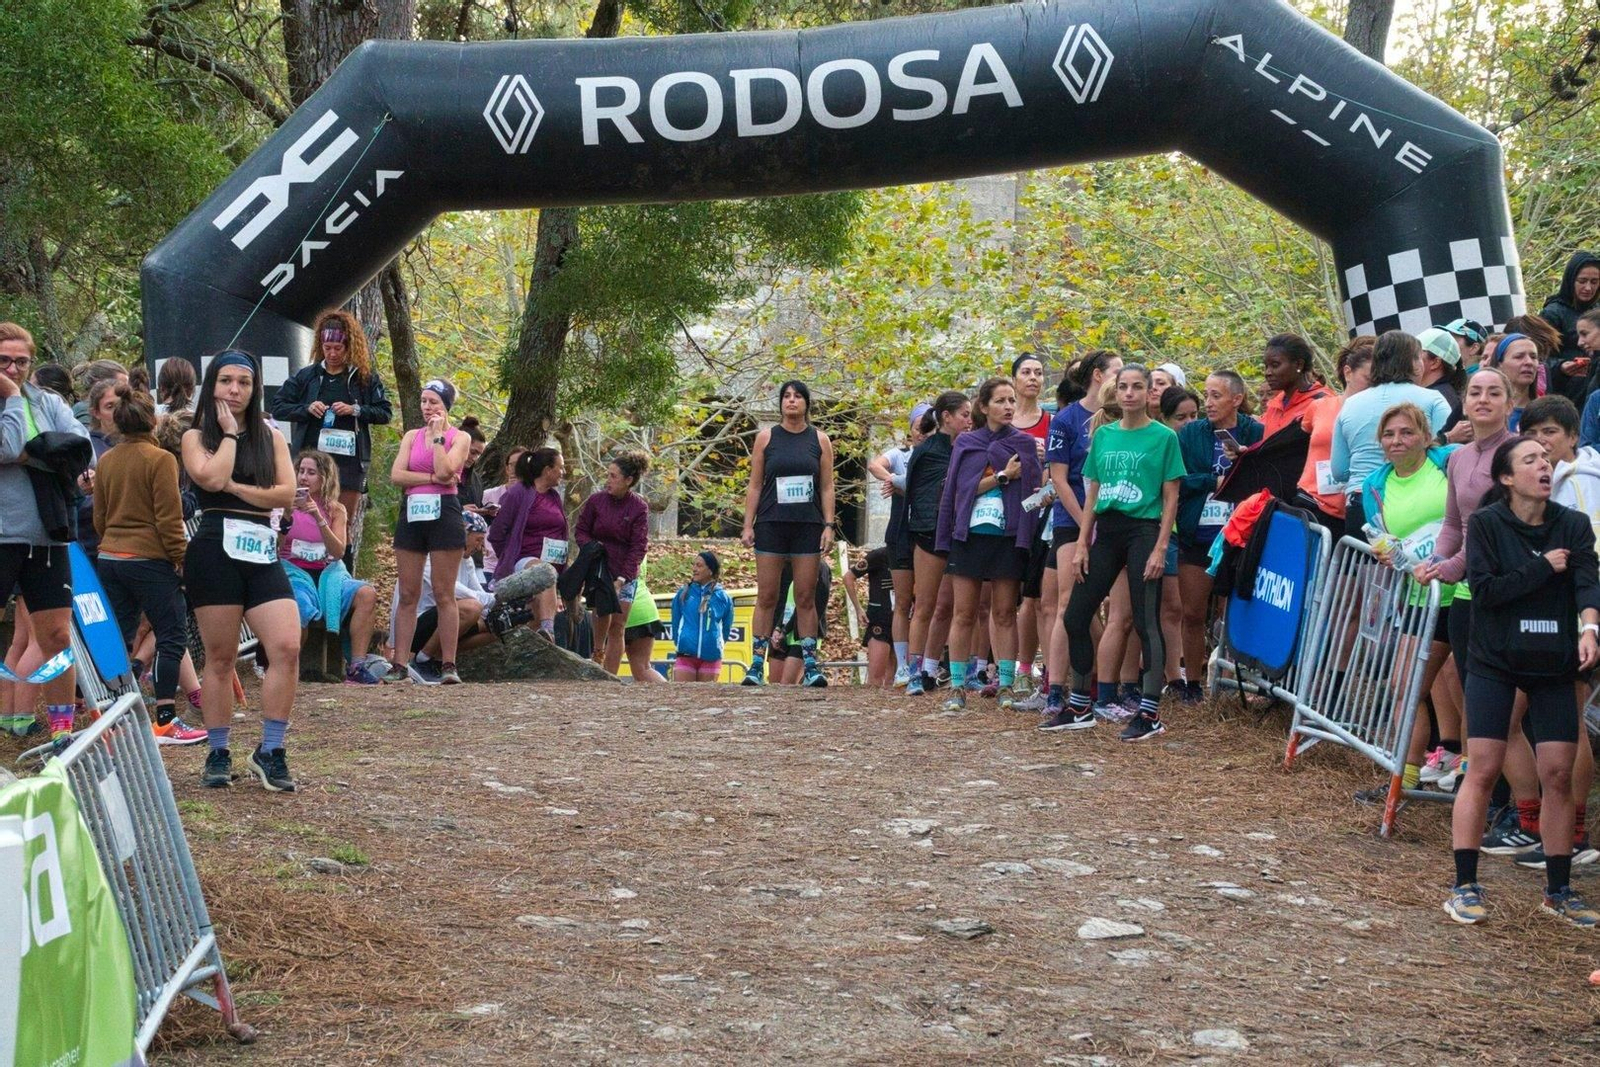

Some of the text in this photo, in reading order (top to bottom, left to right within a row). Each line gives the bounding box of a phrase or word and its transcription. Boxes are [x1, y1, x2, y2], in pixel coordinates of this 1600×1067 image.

[575, 43, 1024, 146] RODOSA
[1218, 34, 1433, 174] ALPINE
[260, 170, 405, 296] DACIA
[325, 436, 347, 449] 1093
[1104, 451, 1147, 470] TRY
[787, 486, 803, 497] 1111
[411, 504, 431, 515] 1243
[975, 506, 999, 519] 1533
[235, 535, 263, 555] 1194
[1252, 566, 1295, 612] CATHLON
[1520, 619, 1559, 633] PUMA
